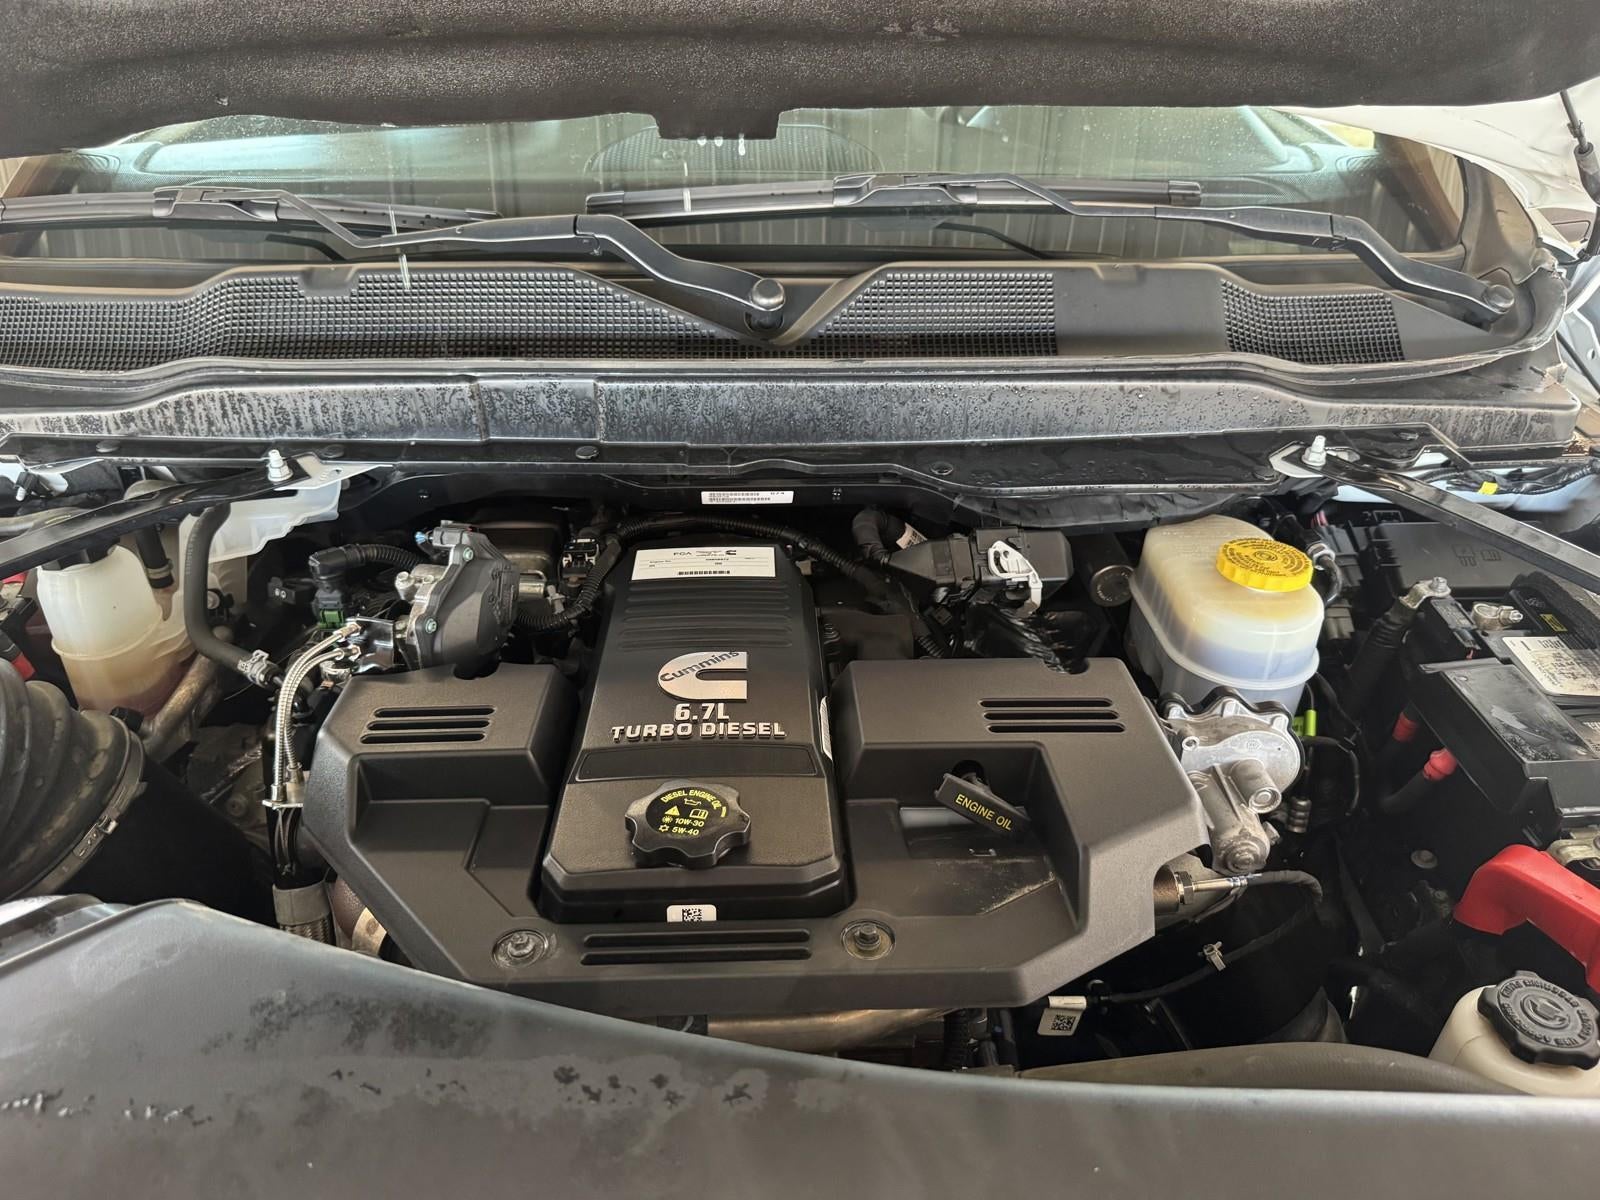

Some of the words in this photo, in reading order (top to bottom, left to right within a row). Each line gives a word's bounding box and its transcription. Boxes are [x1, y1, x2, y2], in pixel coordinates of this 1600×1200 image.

[659, 650, 740, 682] Cummins
[674, 702, 730, 722] 6.7L
[611, 723, 693, 742] TURBO
[701, 722, 787, 739] DIESEL
[660, 790, 688, 803] DIESEL
[688, 789, 717, 802] ENGINE
[711, 800, 722, 810] OIL
[955, 793, 995, 821] ENGINE
[995, 816, 1013, 831] OIL
[671, 826, 700, 836] 5W-40
[675, 817, 705, 828] 10W-30
